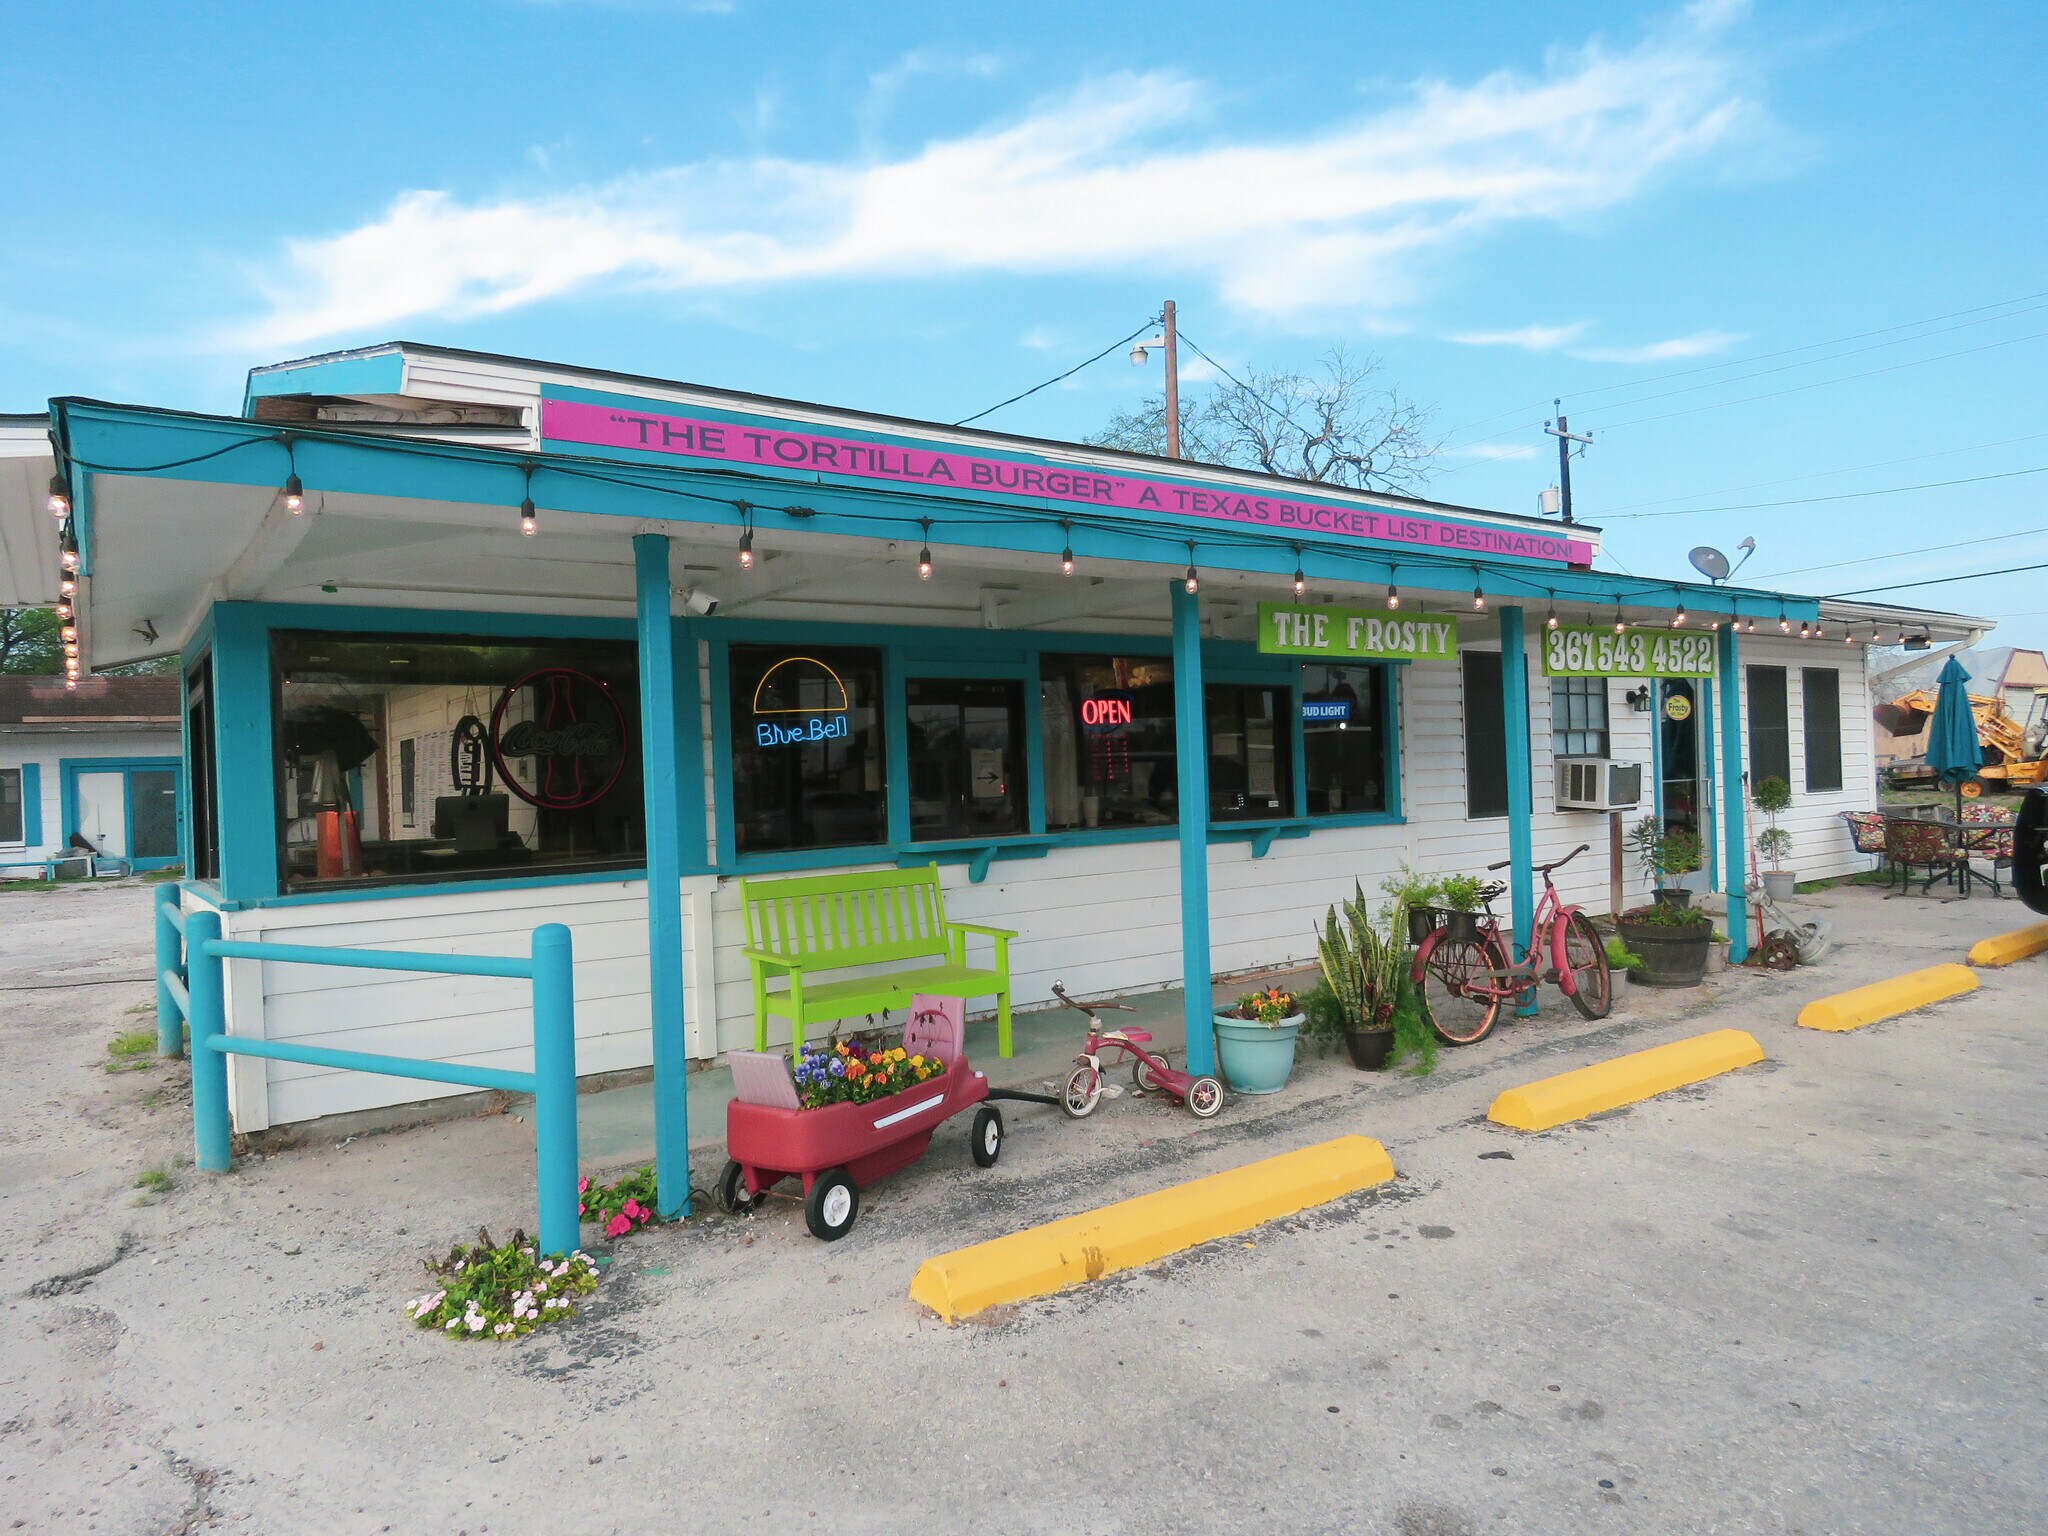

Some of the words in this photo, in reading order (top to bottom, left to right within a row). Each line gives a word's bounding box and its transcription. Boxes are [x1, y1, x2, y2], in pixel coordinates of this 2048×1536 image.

[743, 432, 955, 481] TORTILLA
[1138, 485, 1162, 507] A
[1172, 489, 1270, 521] TEXAS
[1279, 504, 1379, 534] BUCKET
[1387, 519, 1432, 540] LIST
[1439, 526, 1573, 558] DESTINATION!
[1273, 612, 1330, 648] THE
[1347, 617, 1451, 654] FROSTY
[1550, 630, 1595, 671] 361
[1598, 634, 1645, 672] 543
[1651, 636, 1713, 673] 4522
[1082, 699, 1132, 725] OPEN
[1302, 706, 1320, 717] BUD
[1320, 705, 1346, 716] LIGHT
[757, 723, 803, 746] Blue
[809, 716, 848, 740] Bell
